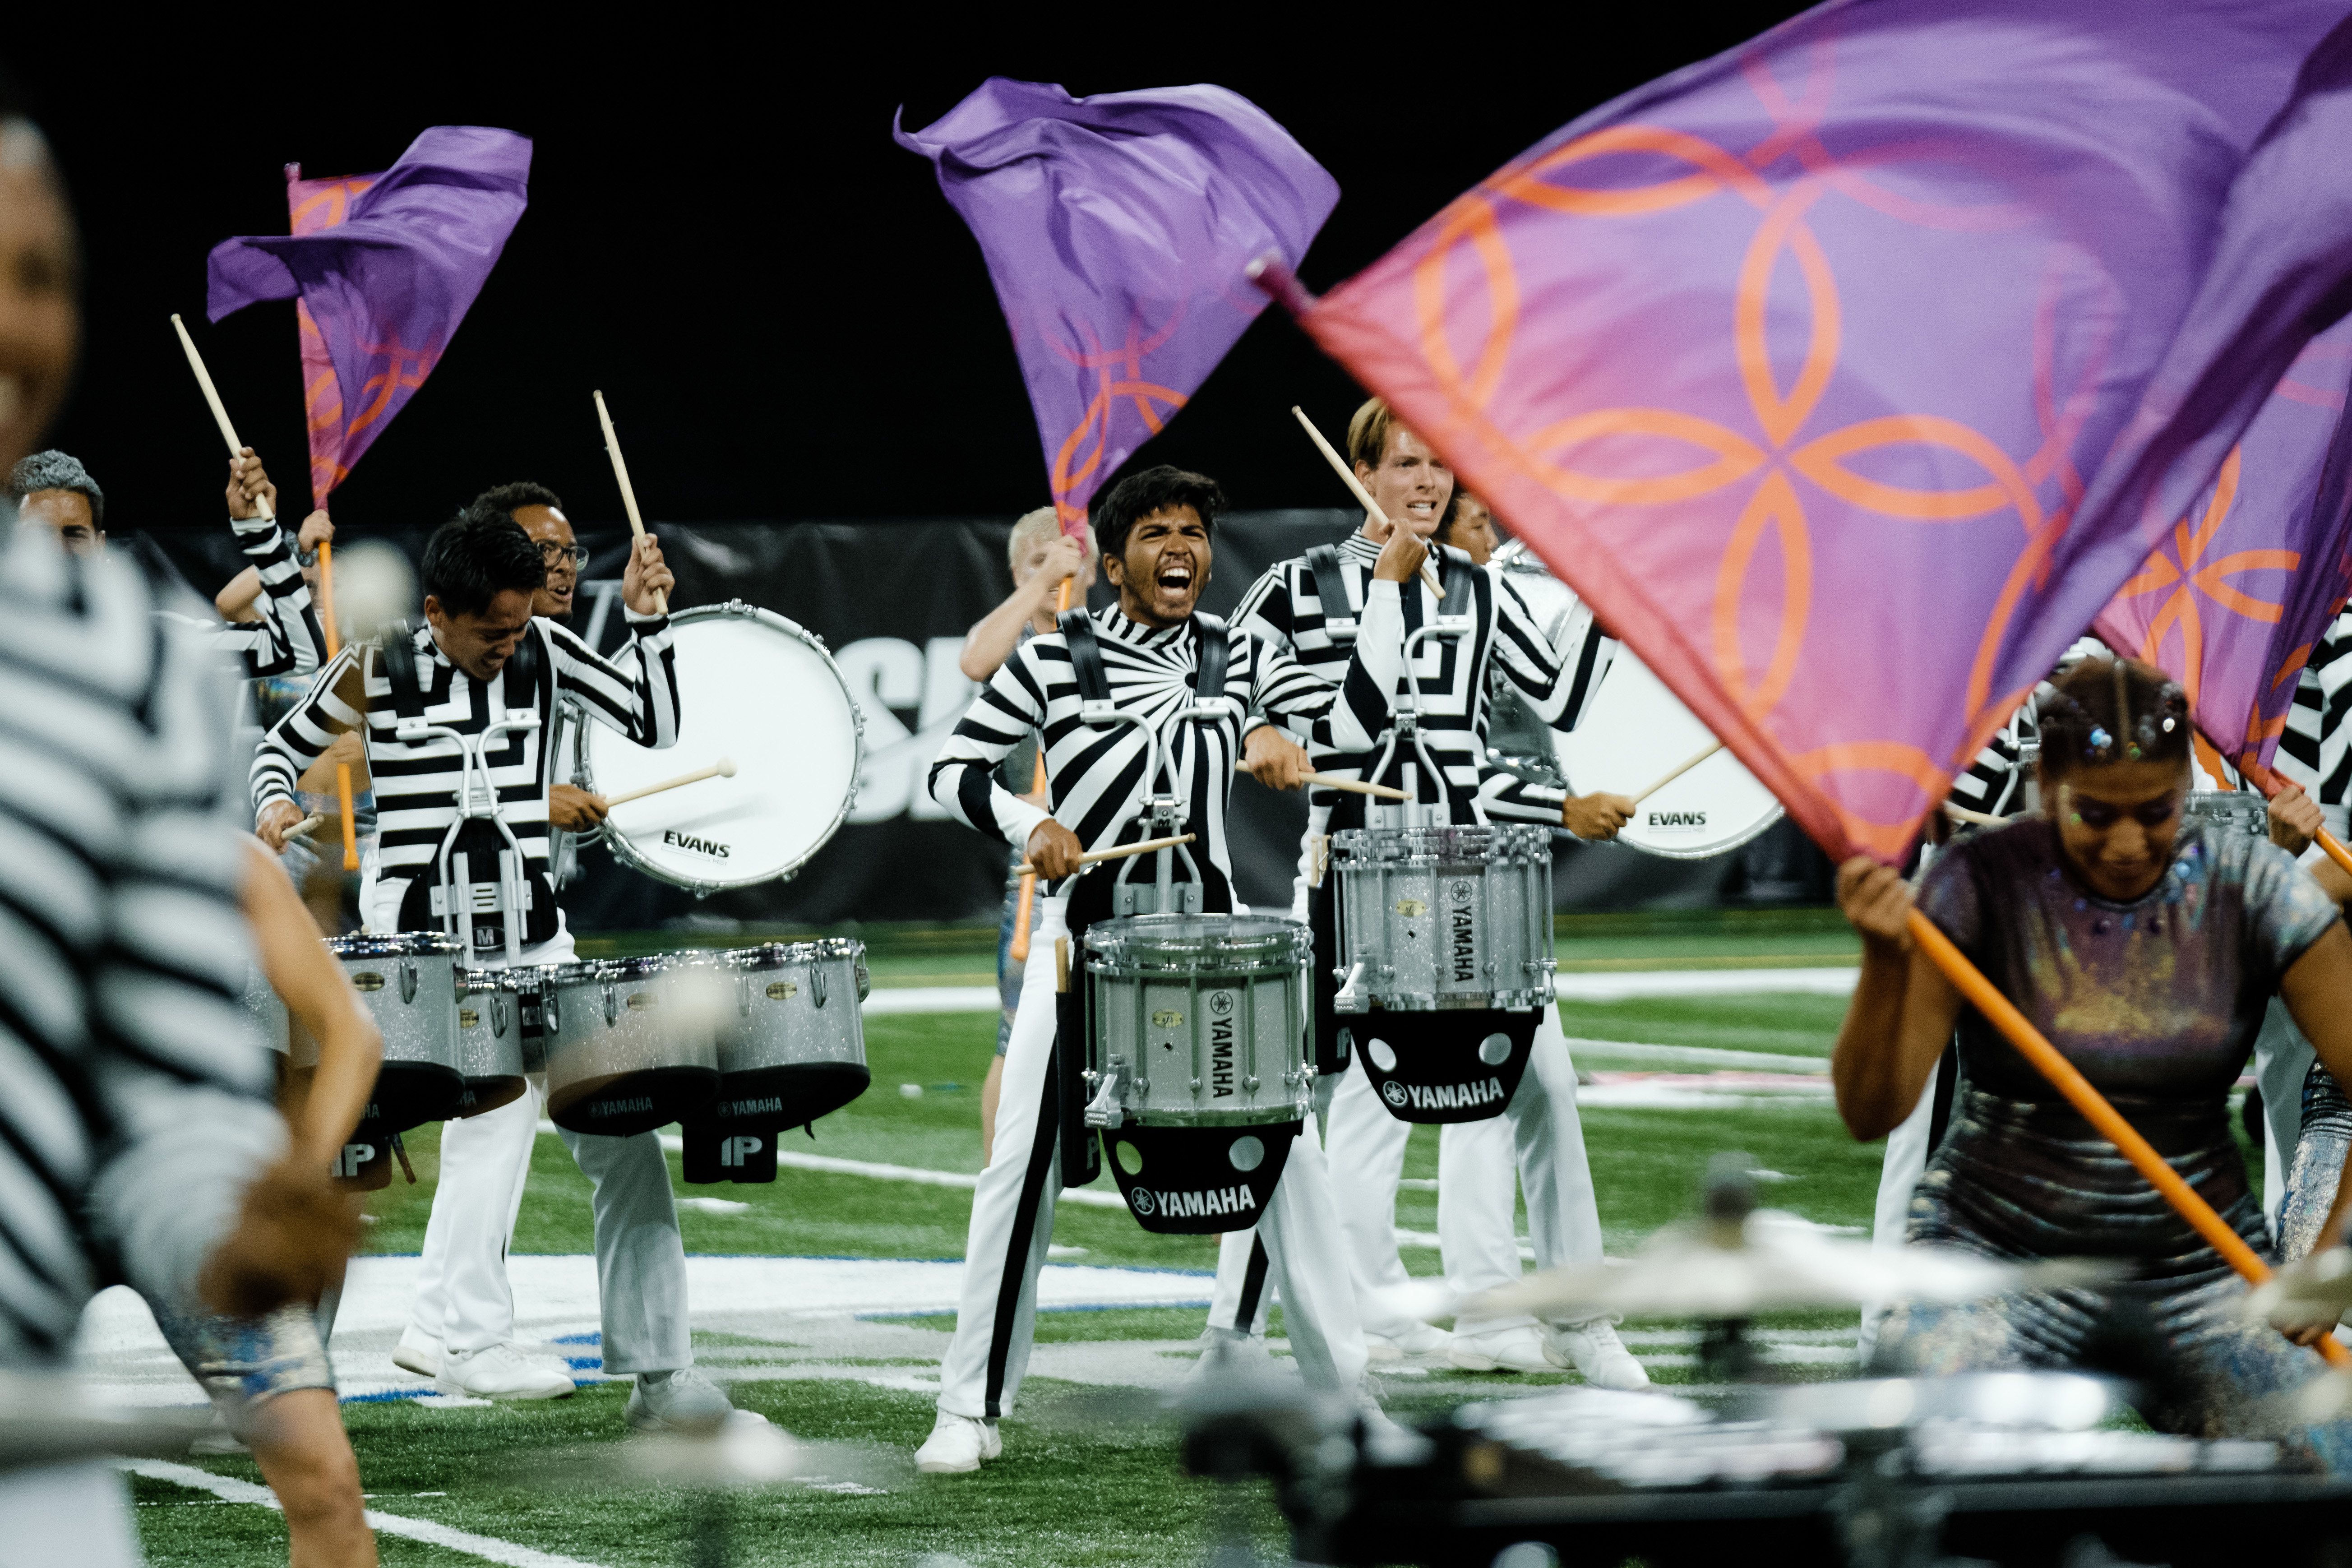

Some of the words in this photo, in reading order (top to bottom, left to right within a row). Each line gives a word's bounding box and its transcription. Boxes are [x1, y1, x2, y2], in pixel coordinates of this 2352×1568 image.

[1158, 819, 1171, 827] M
[1648, 811, 1707, 825] EVANS
[663, 829, 731, 858] EVANS
[476, 928, 494, 946] M
[1452, 905, 1474, 982] YAMAHA
[1212, 1017, 1234, 1098] YAMAHA
[1407, 1077, 1505, 1109] YAMAHA
[601, 1096, 653, 1116] YAMAHA
[732, 1096, 783, 1116] YAMAHA
[1155, 1184, 1256, 1217] YAMAHA
